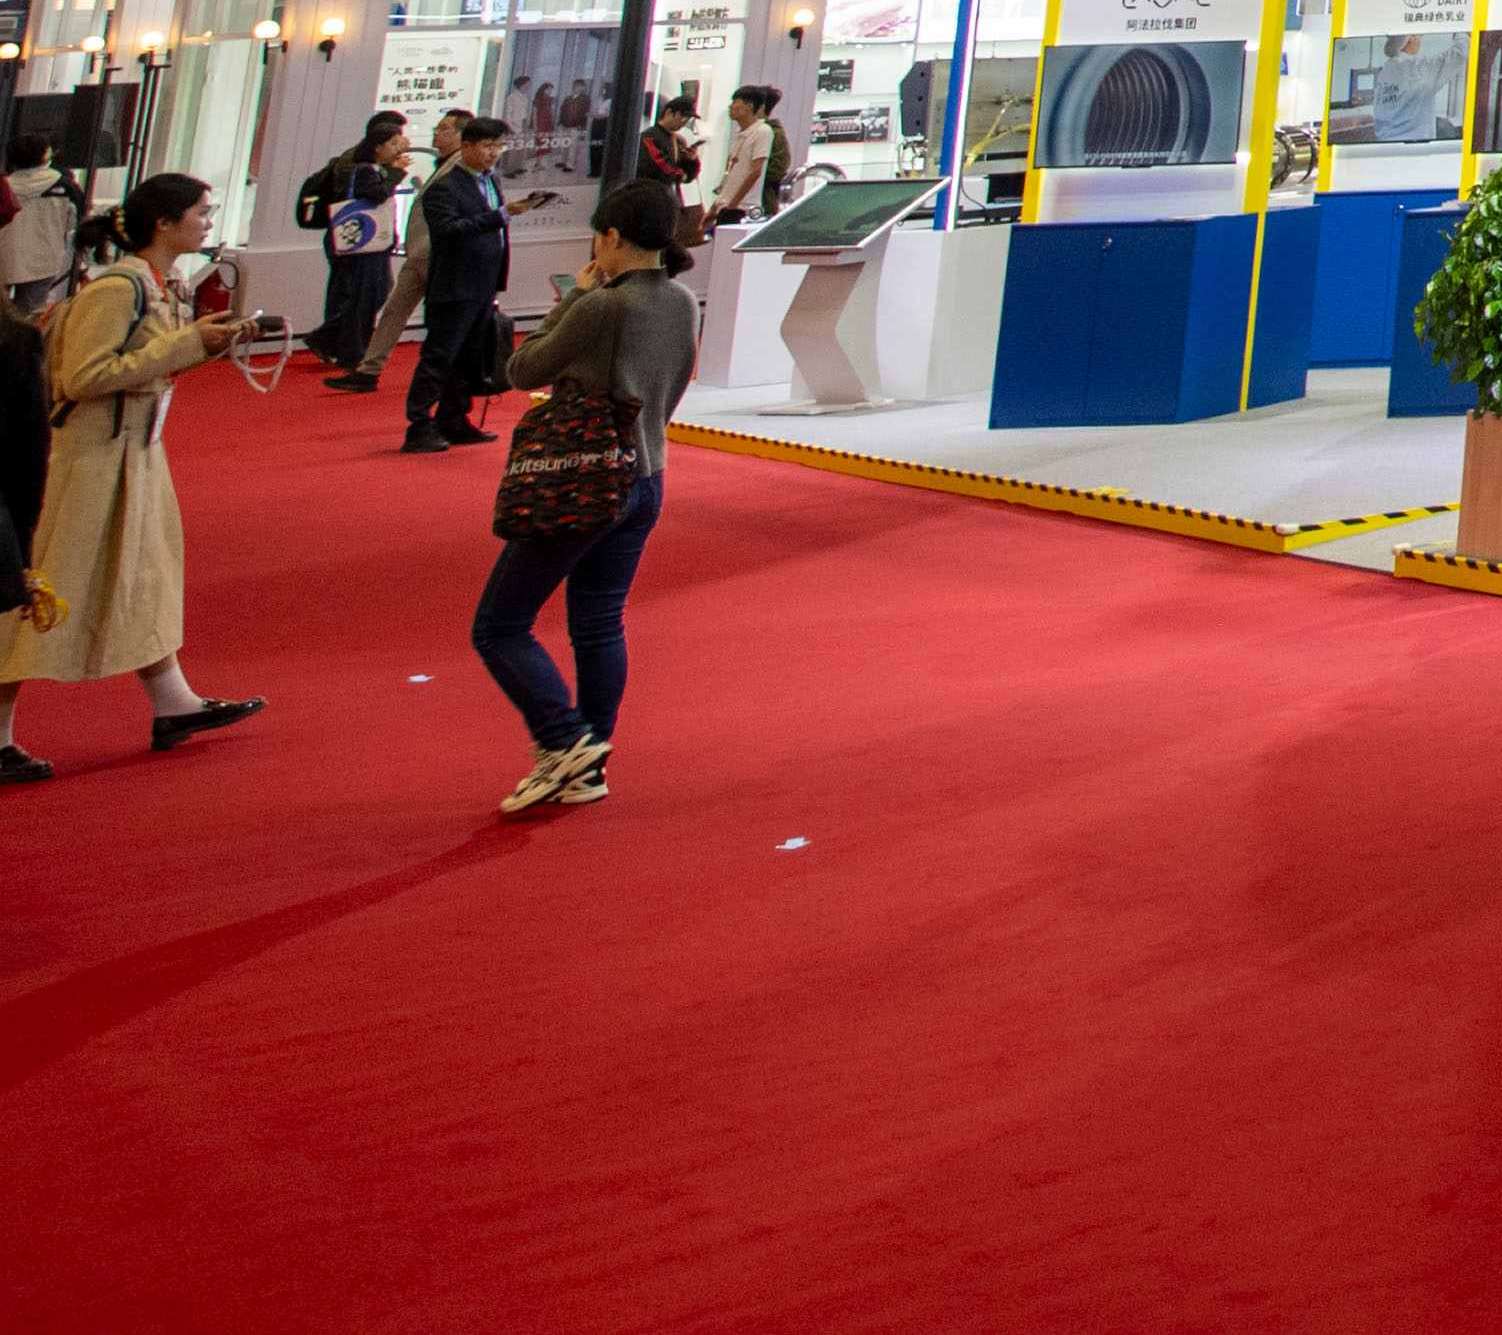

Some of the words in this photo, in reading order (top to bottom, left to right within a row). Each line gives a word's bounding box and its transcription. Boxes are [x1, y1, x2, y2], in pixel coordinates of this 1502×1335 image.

[1126, 17, 1197, 30] 阿法拉伐集团
